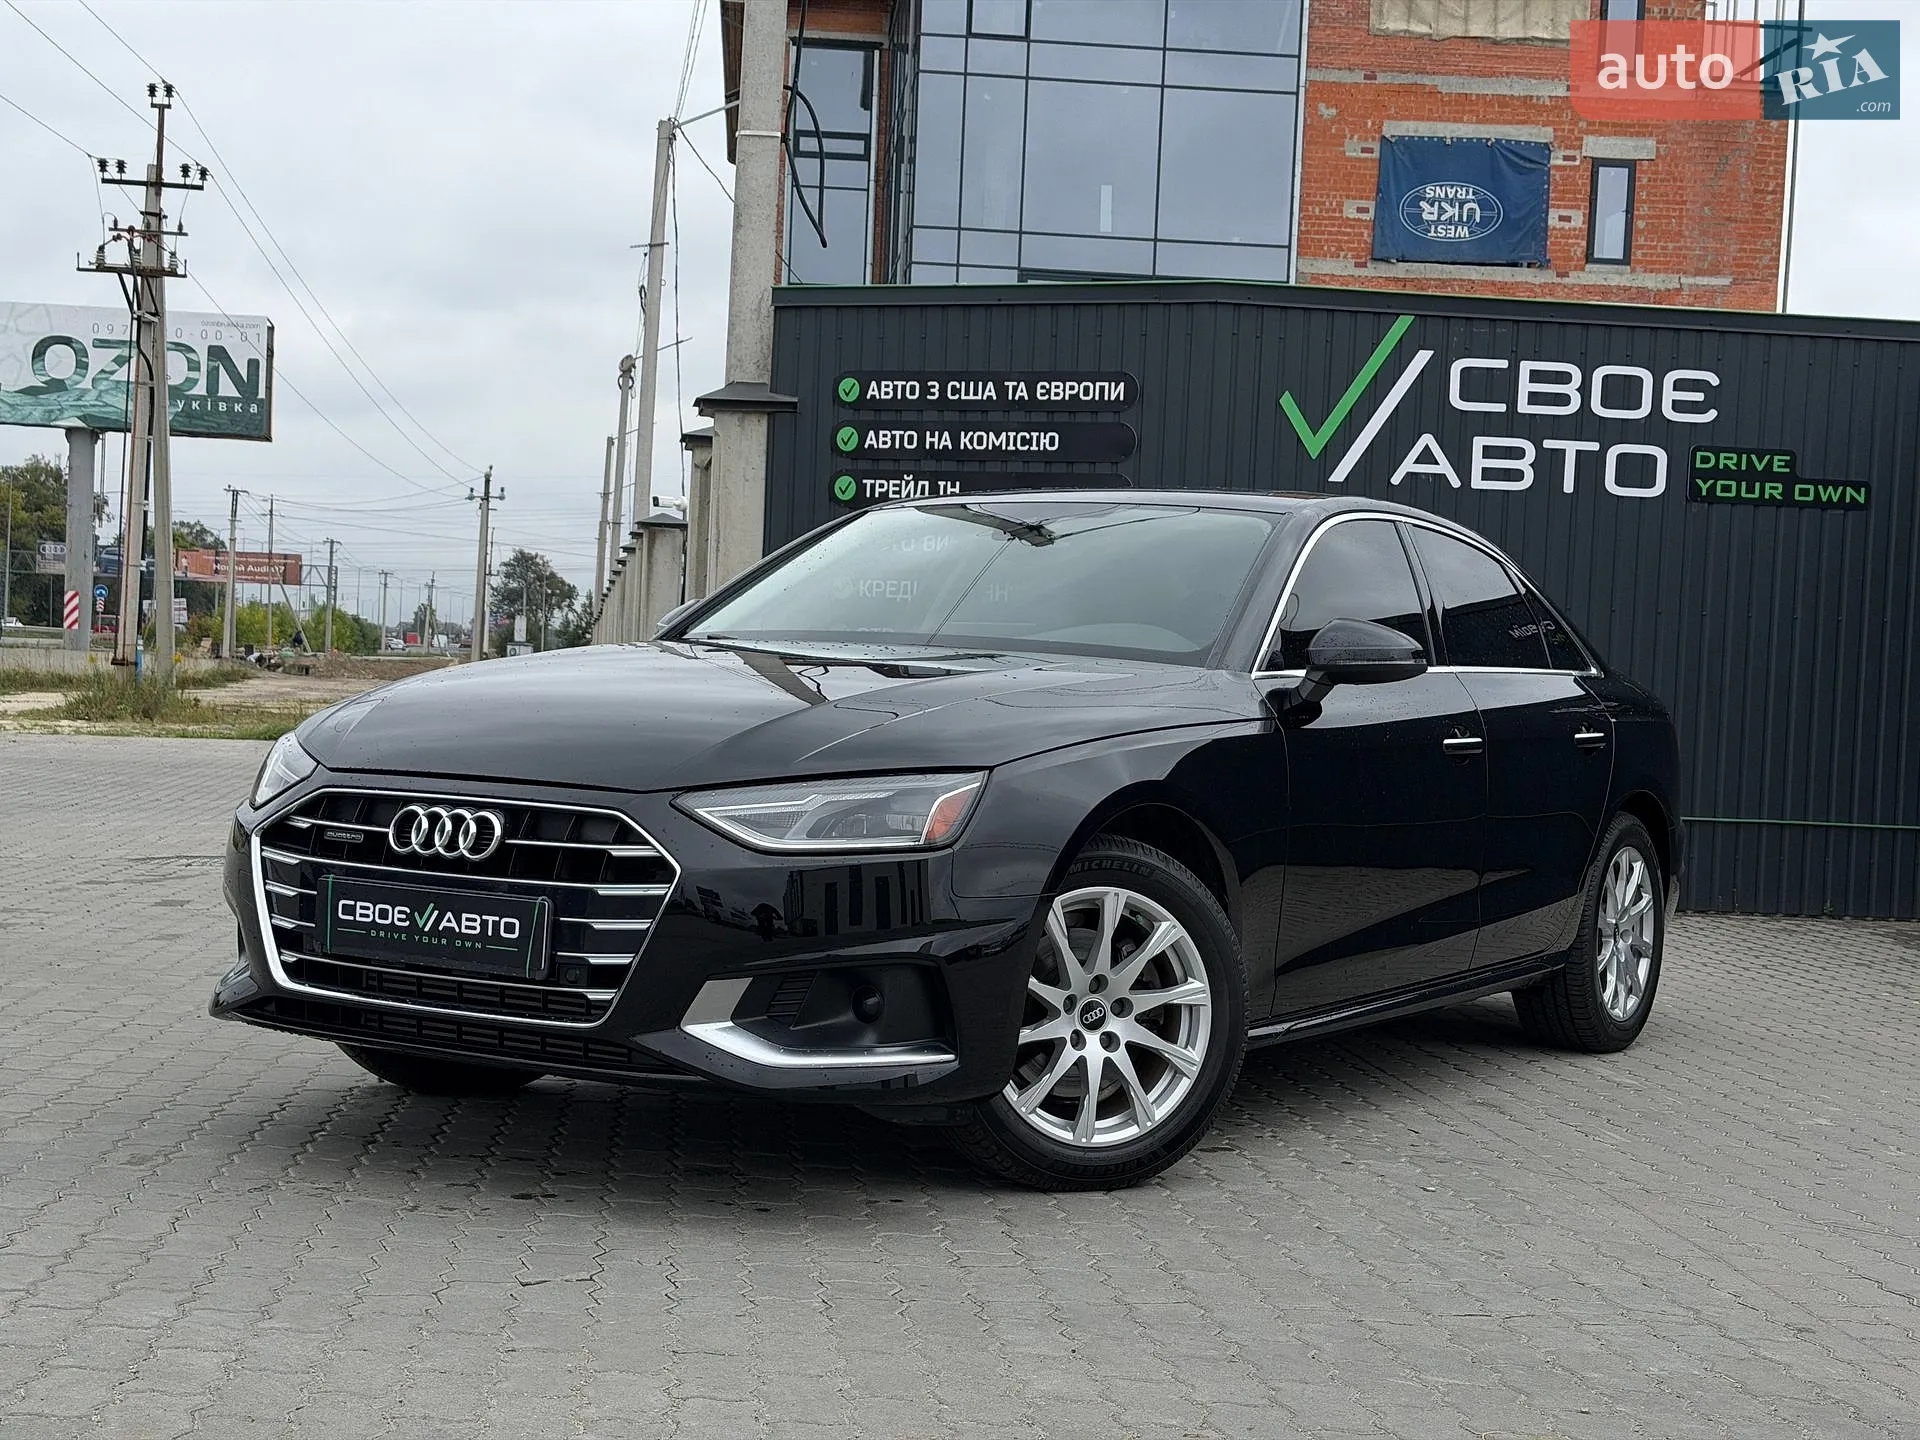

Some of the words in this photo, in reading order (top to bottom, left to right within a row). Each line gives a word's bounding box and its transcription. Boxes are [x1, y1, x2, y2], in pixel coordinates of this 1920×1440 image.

[1425, 186, 1476, 199] TRANS
[1419, 200, 1481, 223] UKR
[1427, 225, 1470, 238] WEST
[866, 380, 920, 400] АВТО
[926, 381, 940, 401] З
[946, 381, 997, 401] США
[1004, 381, 1029, 401] ТА
[1035, 381, 1126, 402] ЄВРОПИ
[1449, 358, 1720, 423] СВОЄ
[176, 399, 259, 415] уківка
[864, 430, 918, 450] АВТО
[925, 431, 953, 450] НА
[959, 431, 1060, 452] КОМІСІЮ
[1389, 433, 1668, 498] АВТО
[1695, 451, 1792, 474] DRIVE
[862, 474, 930, 499] ТРЕЙД
[1695, 478, 1785, 501] YOUR
[1793, 484, 1867, 504] OWN
[337, 899, 411, 927] СВОЄ
[438, 911, 520, 939] АВТО
[370, 929, 407, 941] DRIVE
[413, 935, 448, 945] YOUR
[455, 939, 483, 949] OWN
